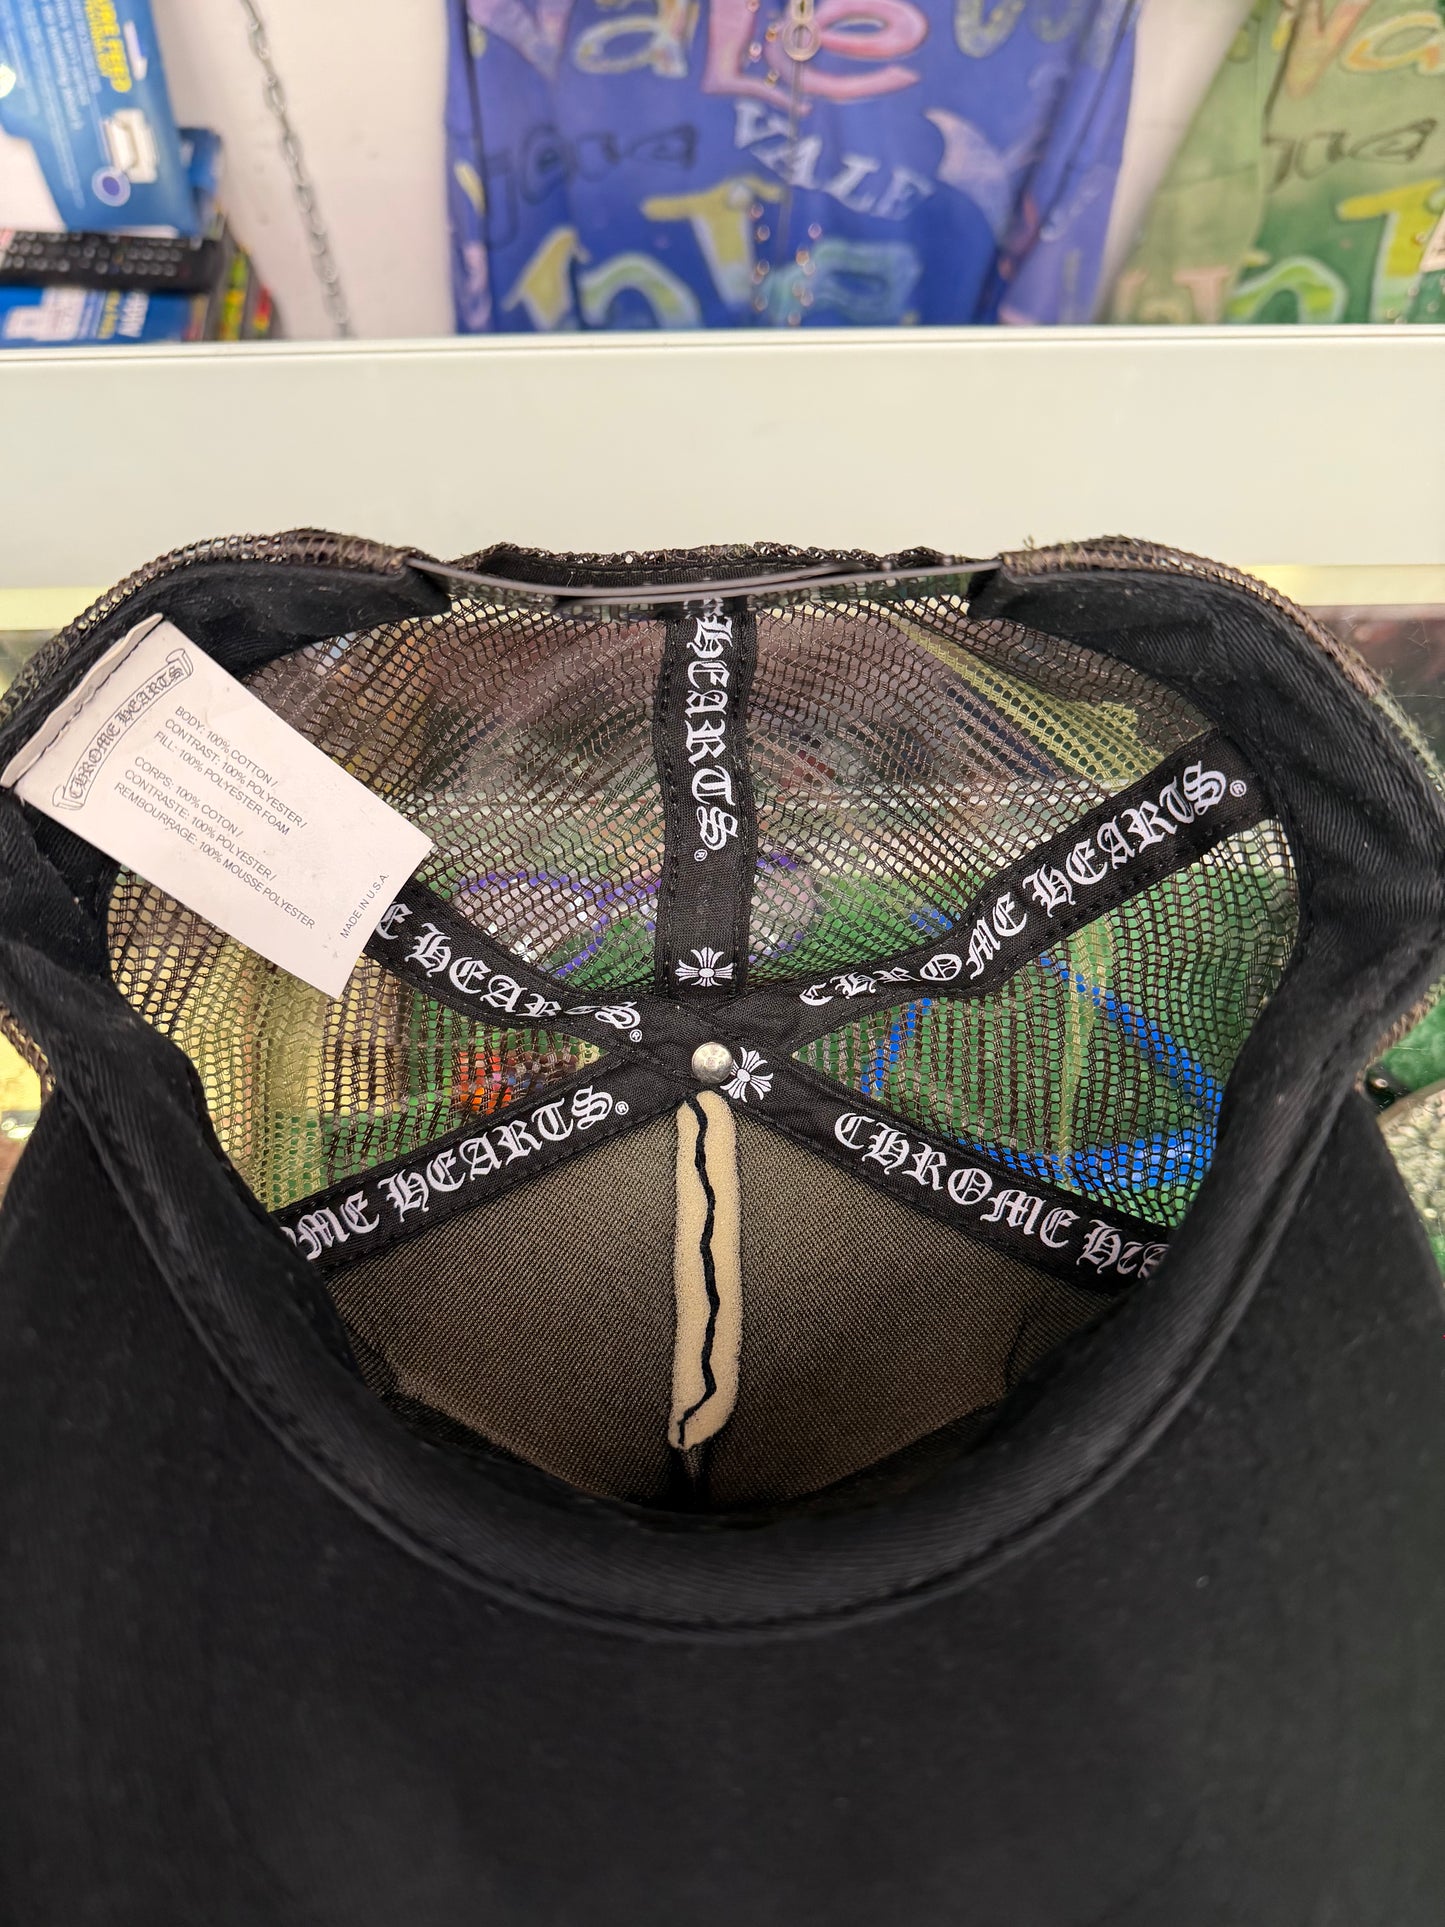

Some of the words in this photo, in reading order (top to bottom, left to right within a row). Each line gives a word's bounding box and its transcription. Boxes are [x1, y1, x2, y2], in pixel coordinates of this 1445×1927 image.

[69, 722, 121, 800] CHROME
[114, 665, 184, 727] HEARTS
[153, 730, 178, 752] FILL:
[179, 749, 204, 773] 100%
[203, 768, 262, 815] POLYESTER
[261, 810, 290, 836] FOAM
[165, 718, 220, 765] CONTRAST:
[222, 761, 247, 785] 100%
[246, 780, 302, 826] POLYESTER
[175, 705, 205, 734] BODY:
[206, 730, 230, 754] 100%
[230, 749, 273, 784] COTTON
[125, 769, 190, 820] CONTRASTE:
[191, 816, 216, 839] 100%
[215, 834, 272, 879] POLYESTER
[134, 756, 174, 789] CORPS:
[176, 785, 201, 809] 100%
[201, 804, 238, 835] COTON
[114, 782, 198, 845] REMBOURRAGE:
[199, 841, 223, 863] 100%
[222, 858, 264, 893] MOUSSE
[262, 887, 316, 929] POLYESTER
[340, 909, 362, 939] MADE
[358, 898, 370, 911] IN
[366, 874, 390, 899] U.S.A.
[799, 891, 1028, 1007] CHROME
[834, 1112, 1081, 1251] CHROME
